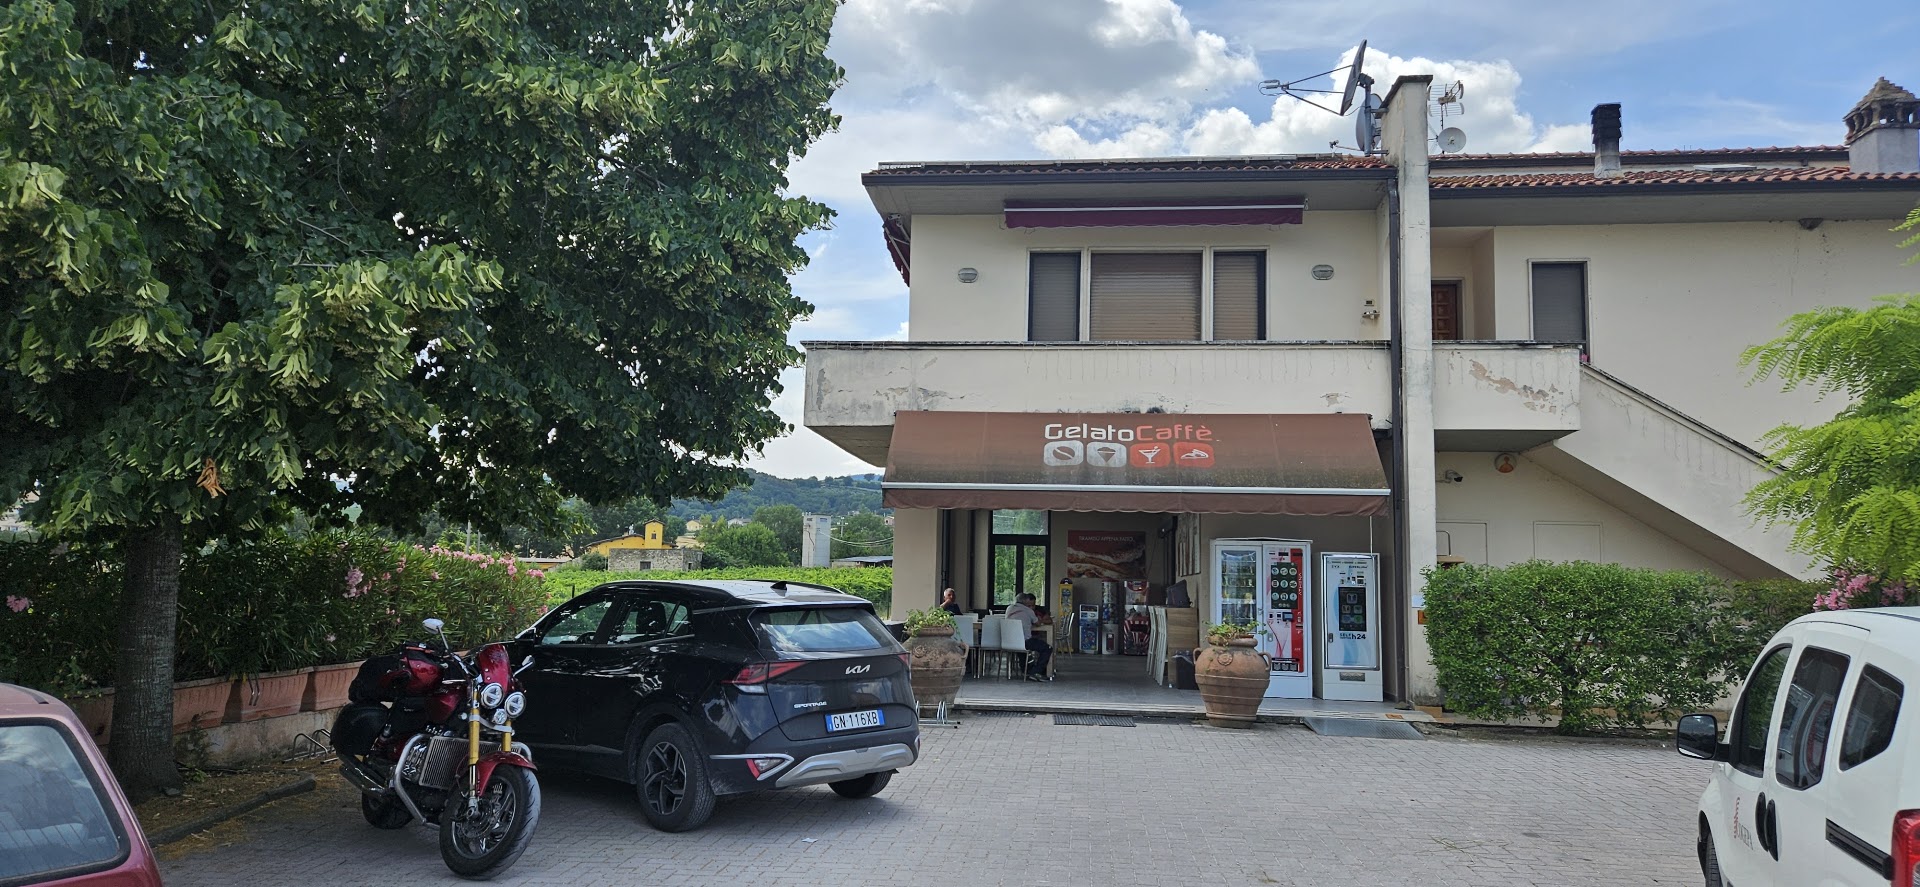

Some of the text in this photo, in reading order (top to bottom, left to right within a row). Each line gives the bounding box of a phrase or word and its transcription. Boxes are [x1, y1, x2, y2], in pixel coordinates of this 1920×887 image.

[845, 664, 870, 675] KIA
[794, 701, 827, 709] SPORTAGE
[833, 711, 878, 729] GN 116XB
